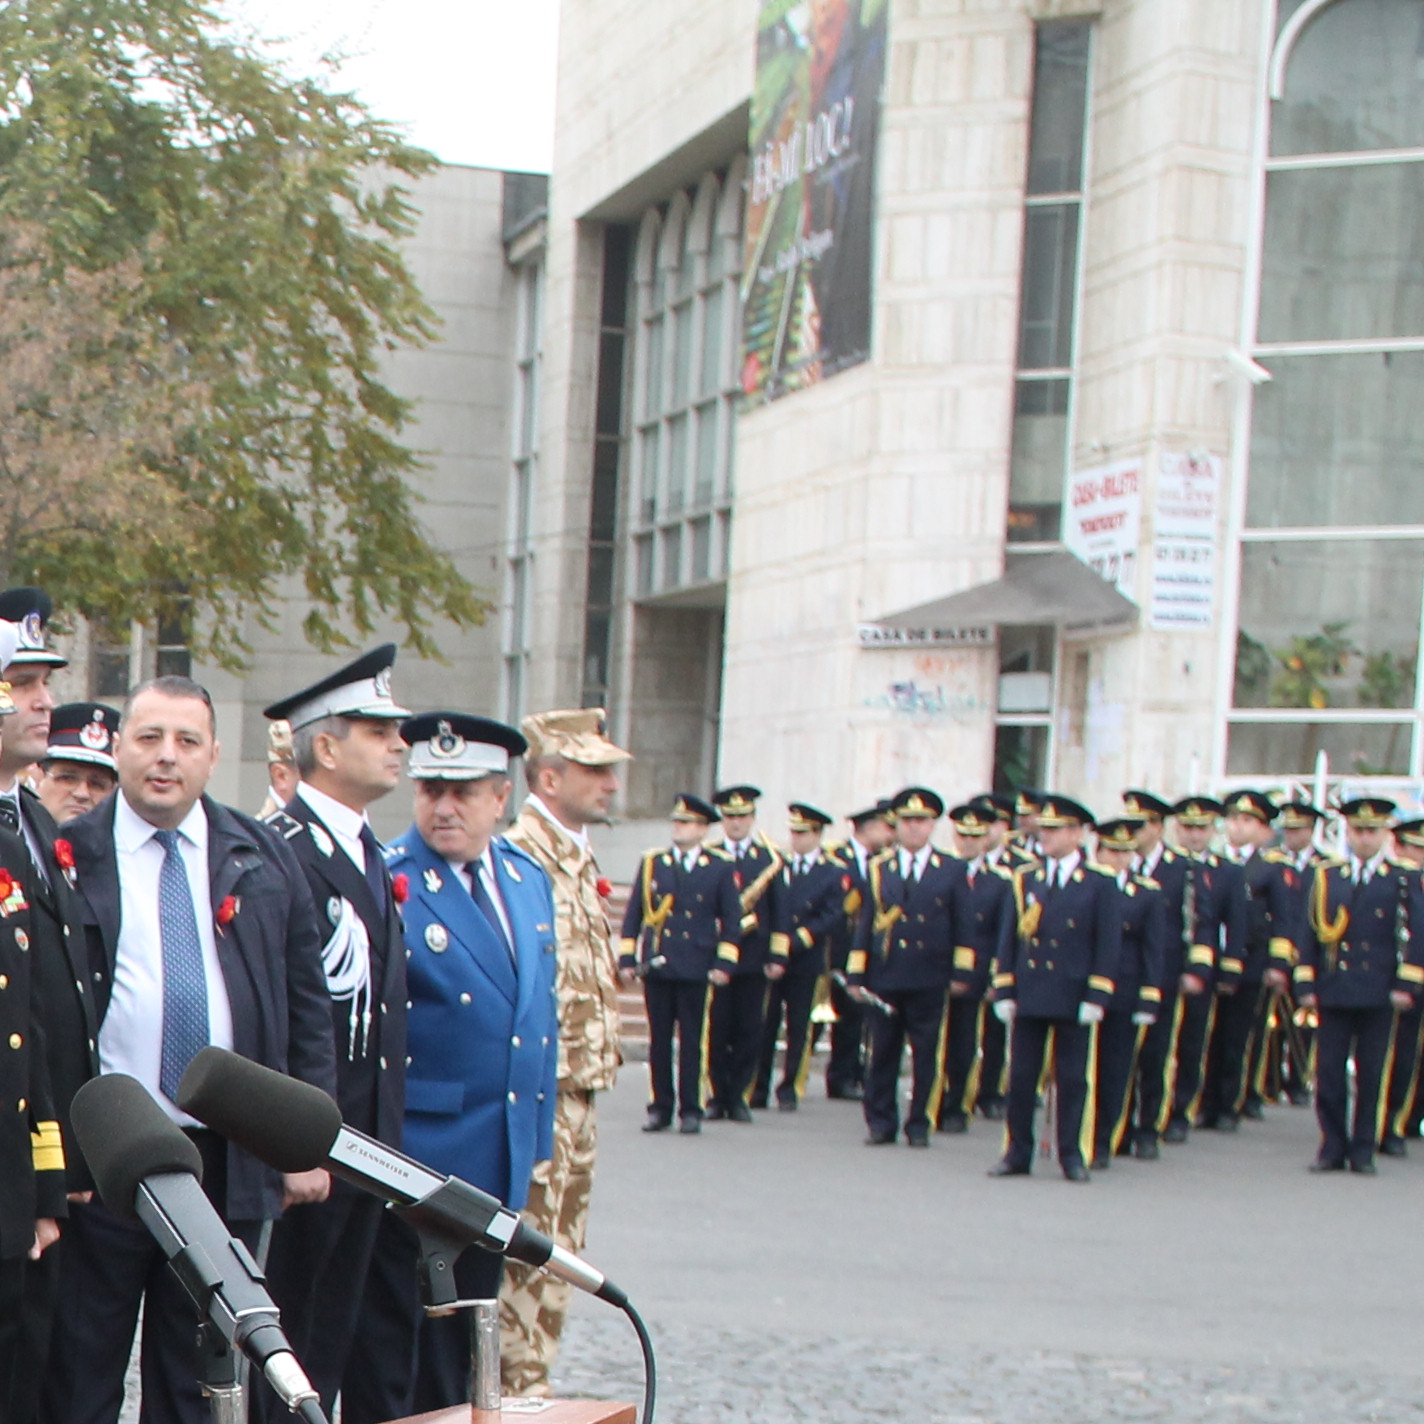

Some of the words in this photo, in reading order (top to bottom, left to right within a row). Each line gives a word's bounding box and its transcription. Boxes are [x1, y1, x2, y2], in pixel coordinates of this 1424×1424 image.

[860, 628, 901, 641] CASA
[932, 627, 988, 641] BILETE
[358, 1147, 410, 1178] SENNHEISER
